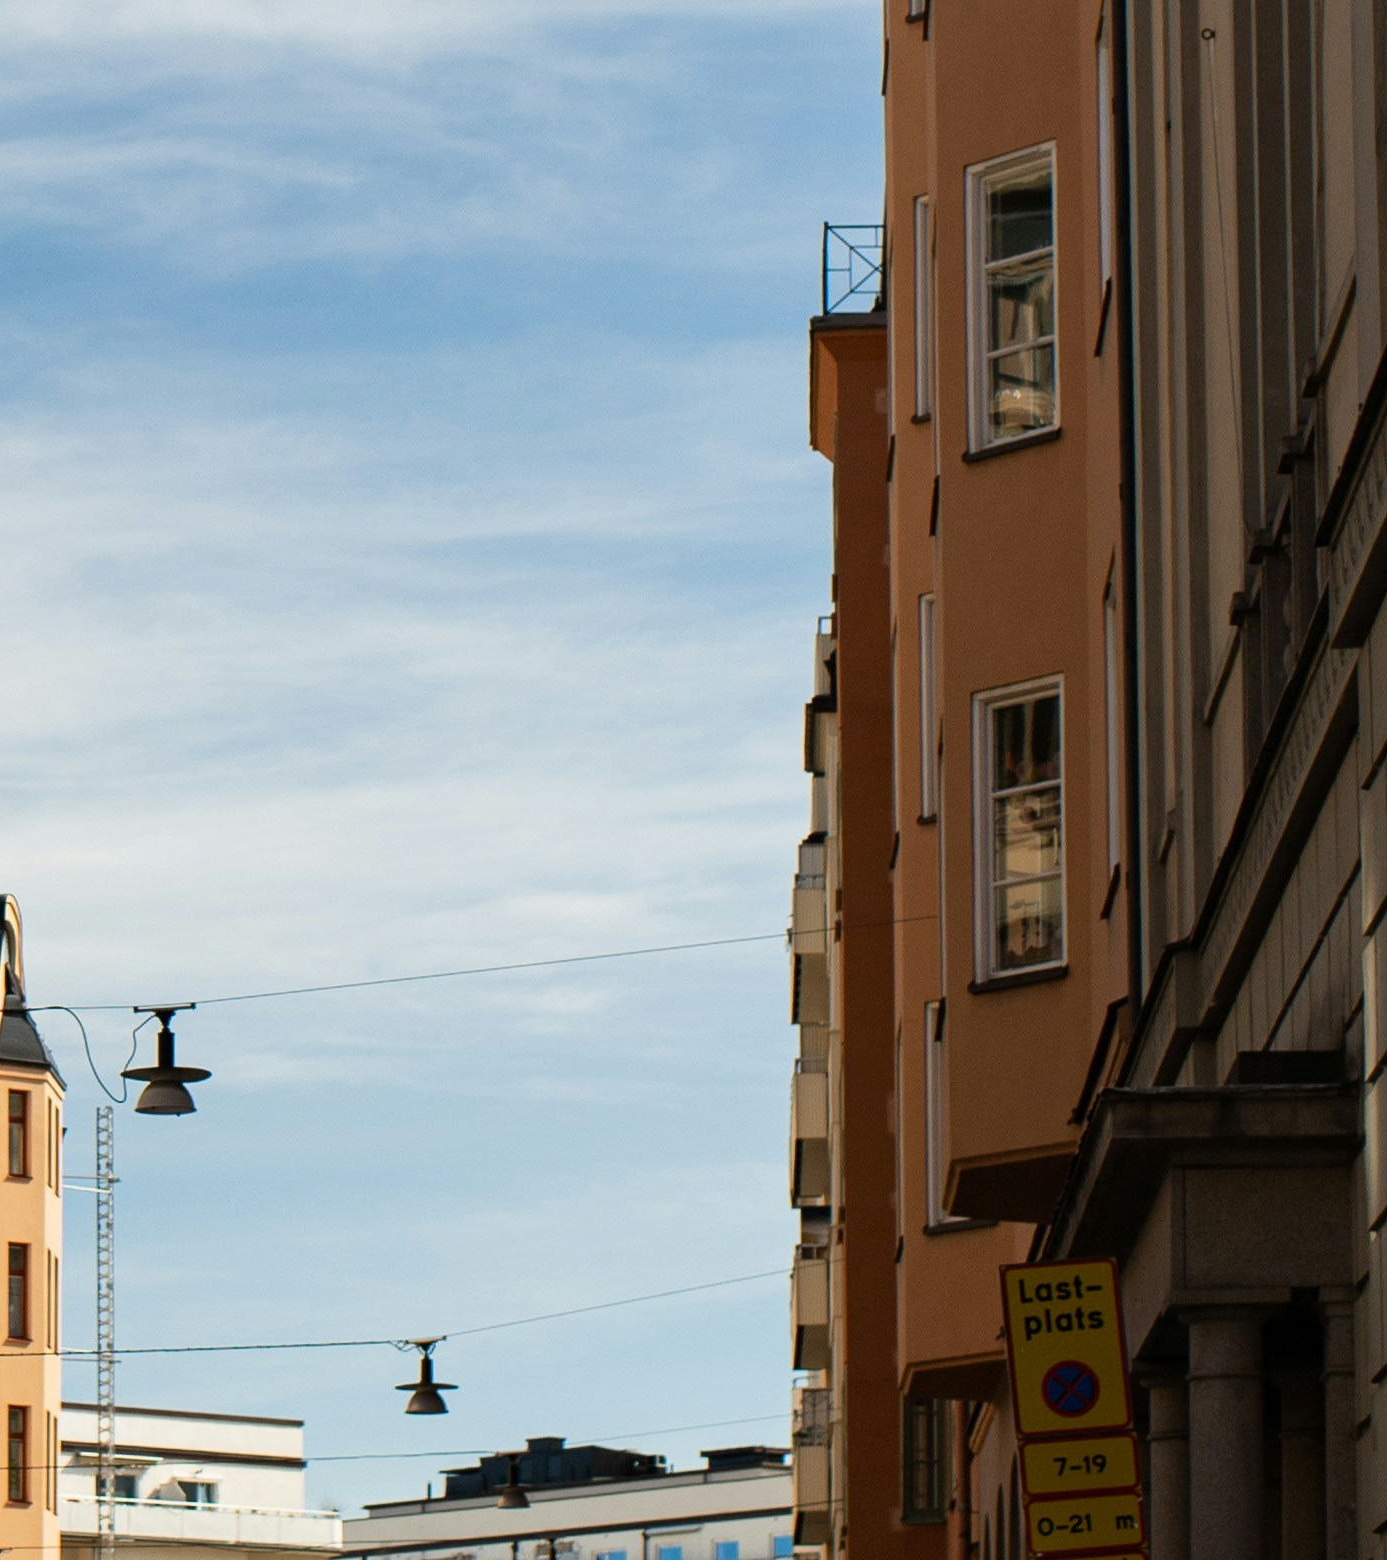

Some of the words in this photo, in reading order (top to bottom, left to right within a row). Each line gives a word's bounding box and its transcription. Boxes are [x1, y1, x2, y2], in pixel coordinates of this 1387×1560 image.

[1019, 1274, 1103, 1304] Last-
[1024, 1307, 1104, 1341] plats
[1053, 1454, 1107, 1477] 7-19
[1037, 1512, 1093, 1537] 0-21
[1115, 1514, 1137, 1530] m
